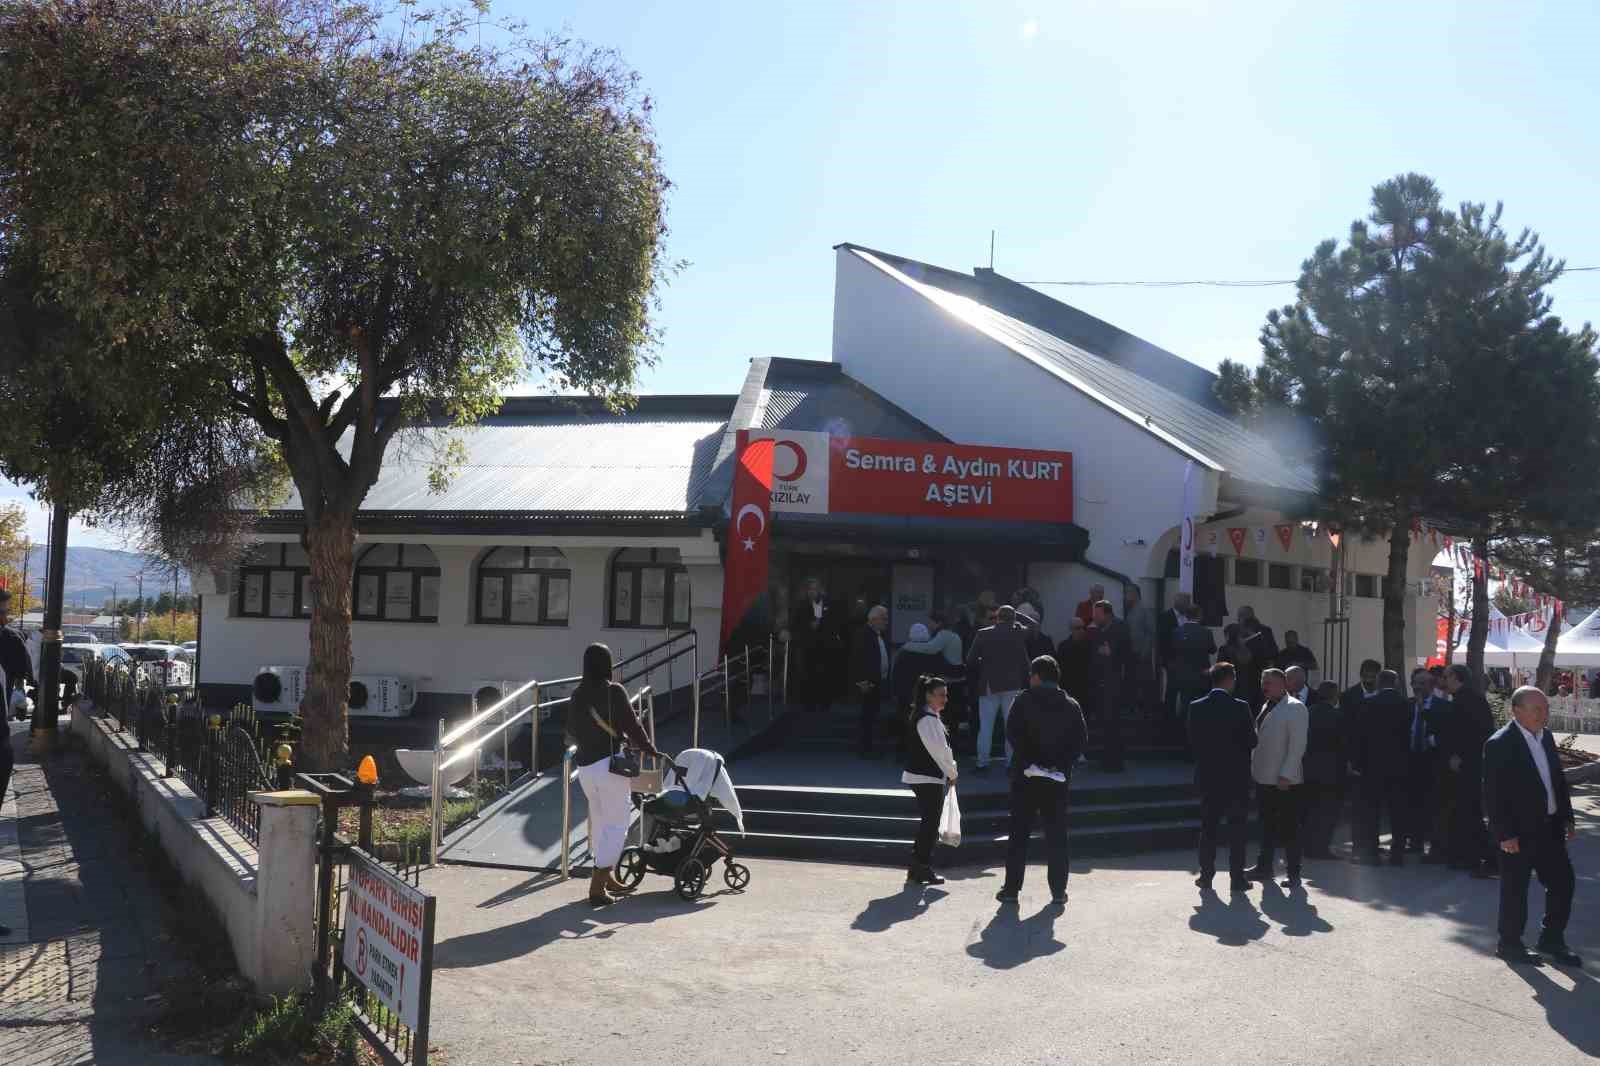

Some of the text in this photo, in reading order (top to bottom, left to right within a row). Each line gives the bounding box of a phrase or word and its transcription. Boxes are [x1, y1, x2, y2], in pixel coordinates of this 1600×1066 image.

[846, 450, 1063, 482] Semra & Aydın KURT
[925, 481, 993, 508] AŞEVİ
